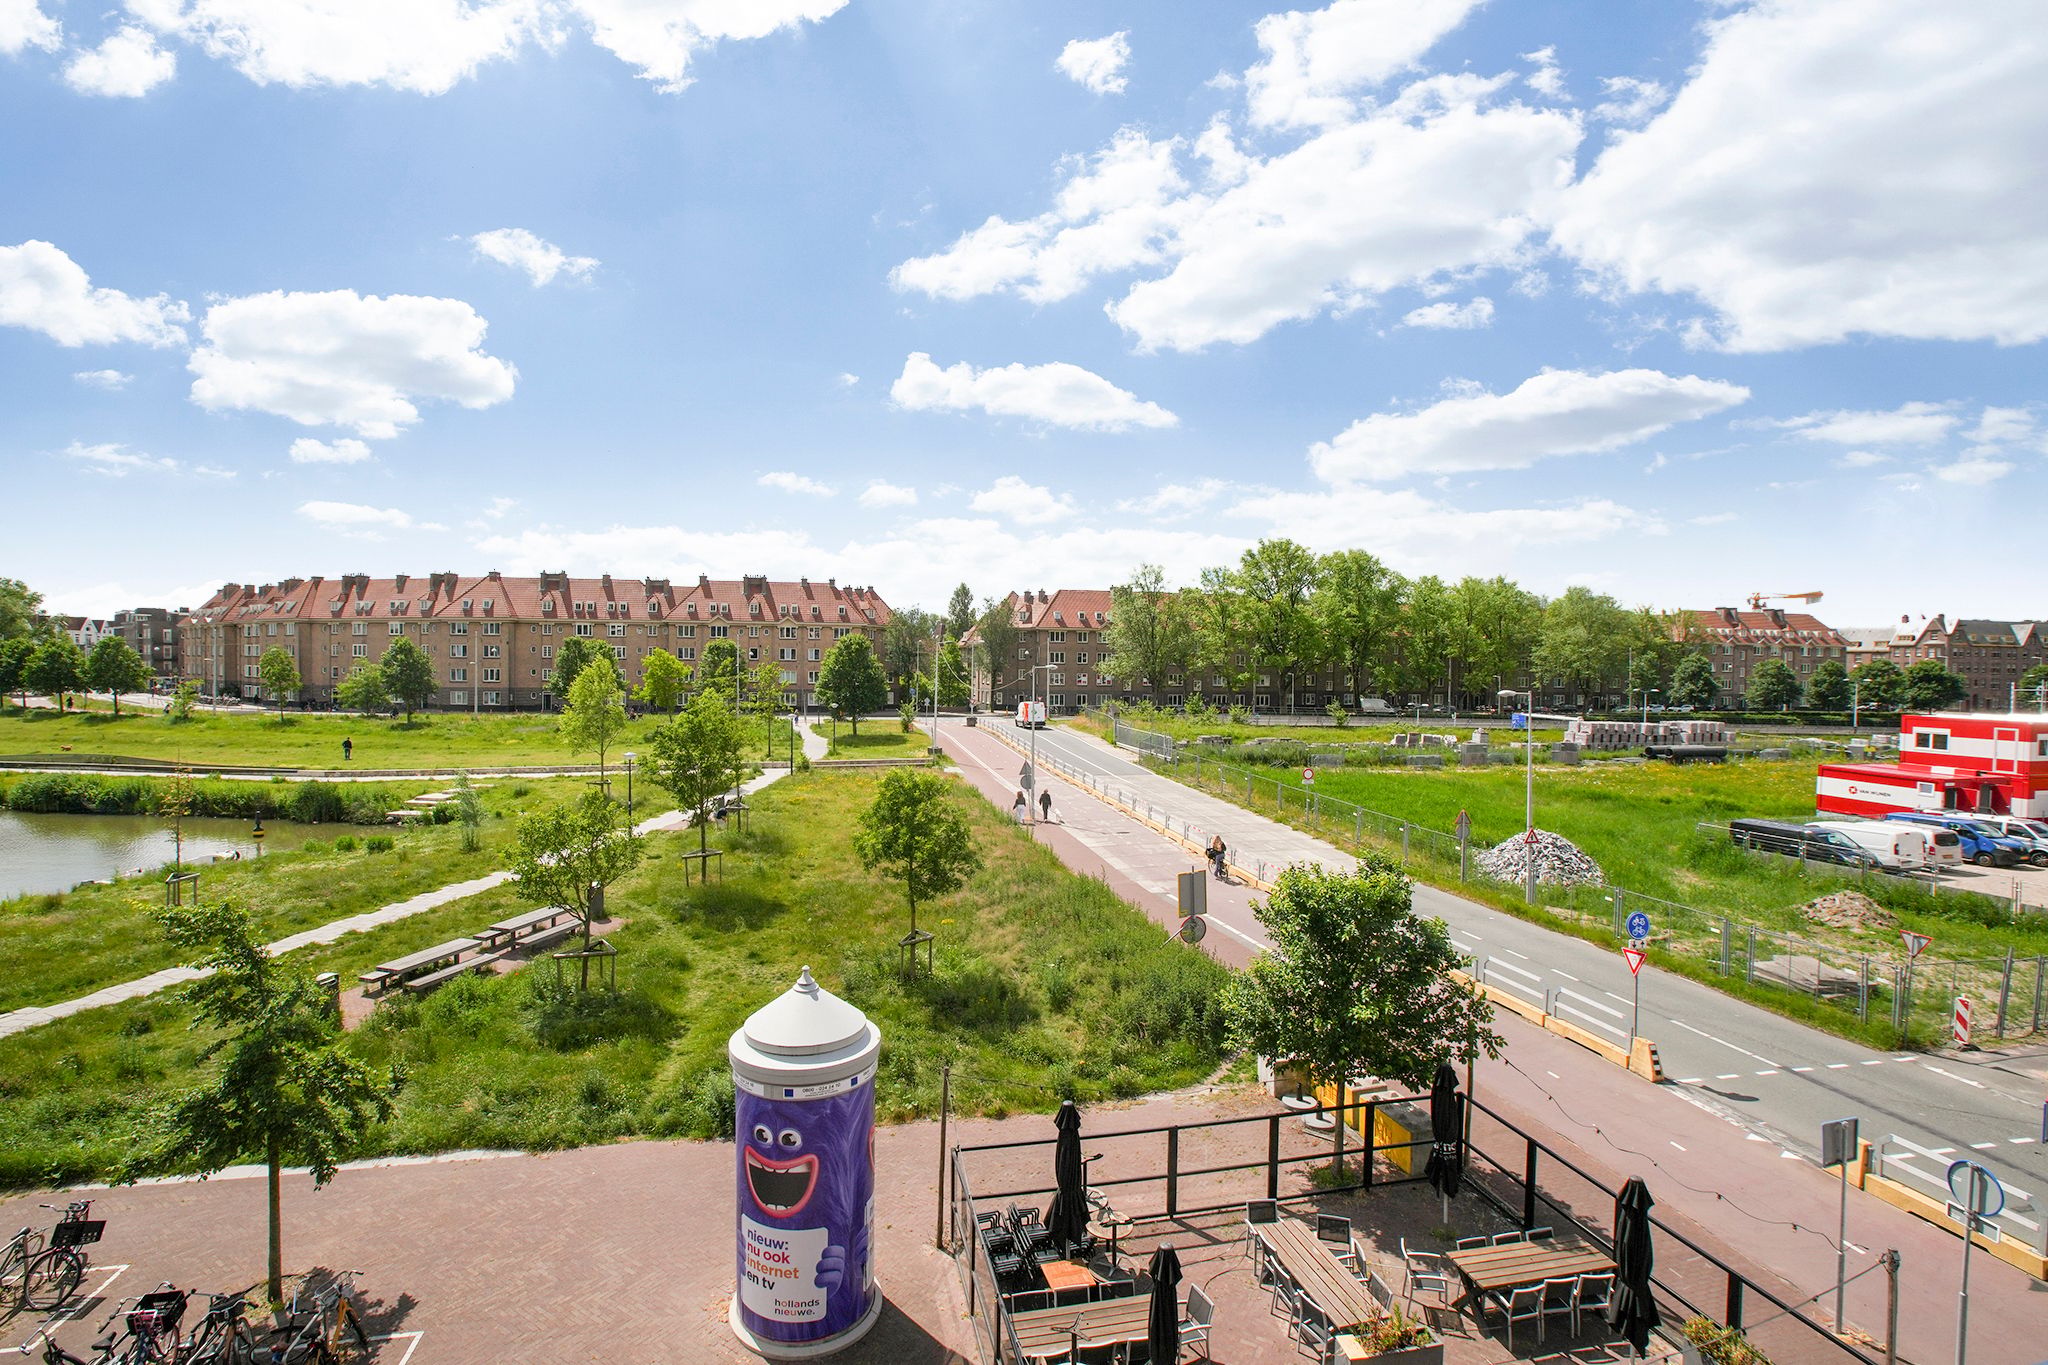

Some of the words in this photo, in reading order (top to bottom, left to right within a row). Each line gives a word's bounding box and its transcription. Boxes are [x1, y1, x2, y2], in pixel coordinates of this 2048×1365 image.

[747, 1229, 789, 1250] nieuw:
[747, 1242, 760, 1257] nu
[763, 1251, 790, 1264] ook
[747, 1254, 799, 1279] internet
[746, 1270, 759, 1285] en
[762, 1277, 775, 1290] tv
[774, 1298, 820, 1308] hollands
[774, 1307, 816, 1317] nieuwe.
